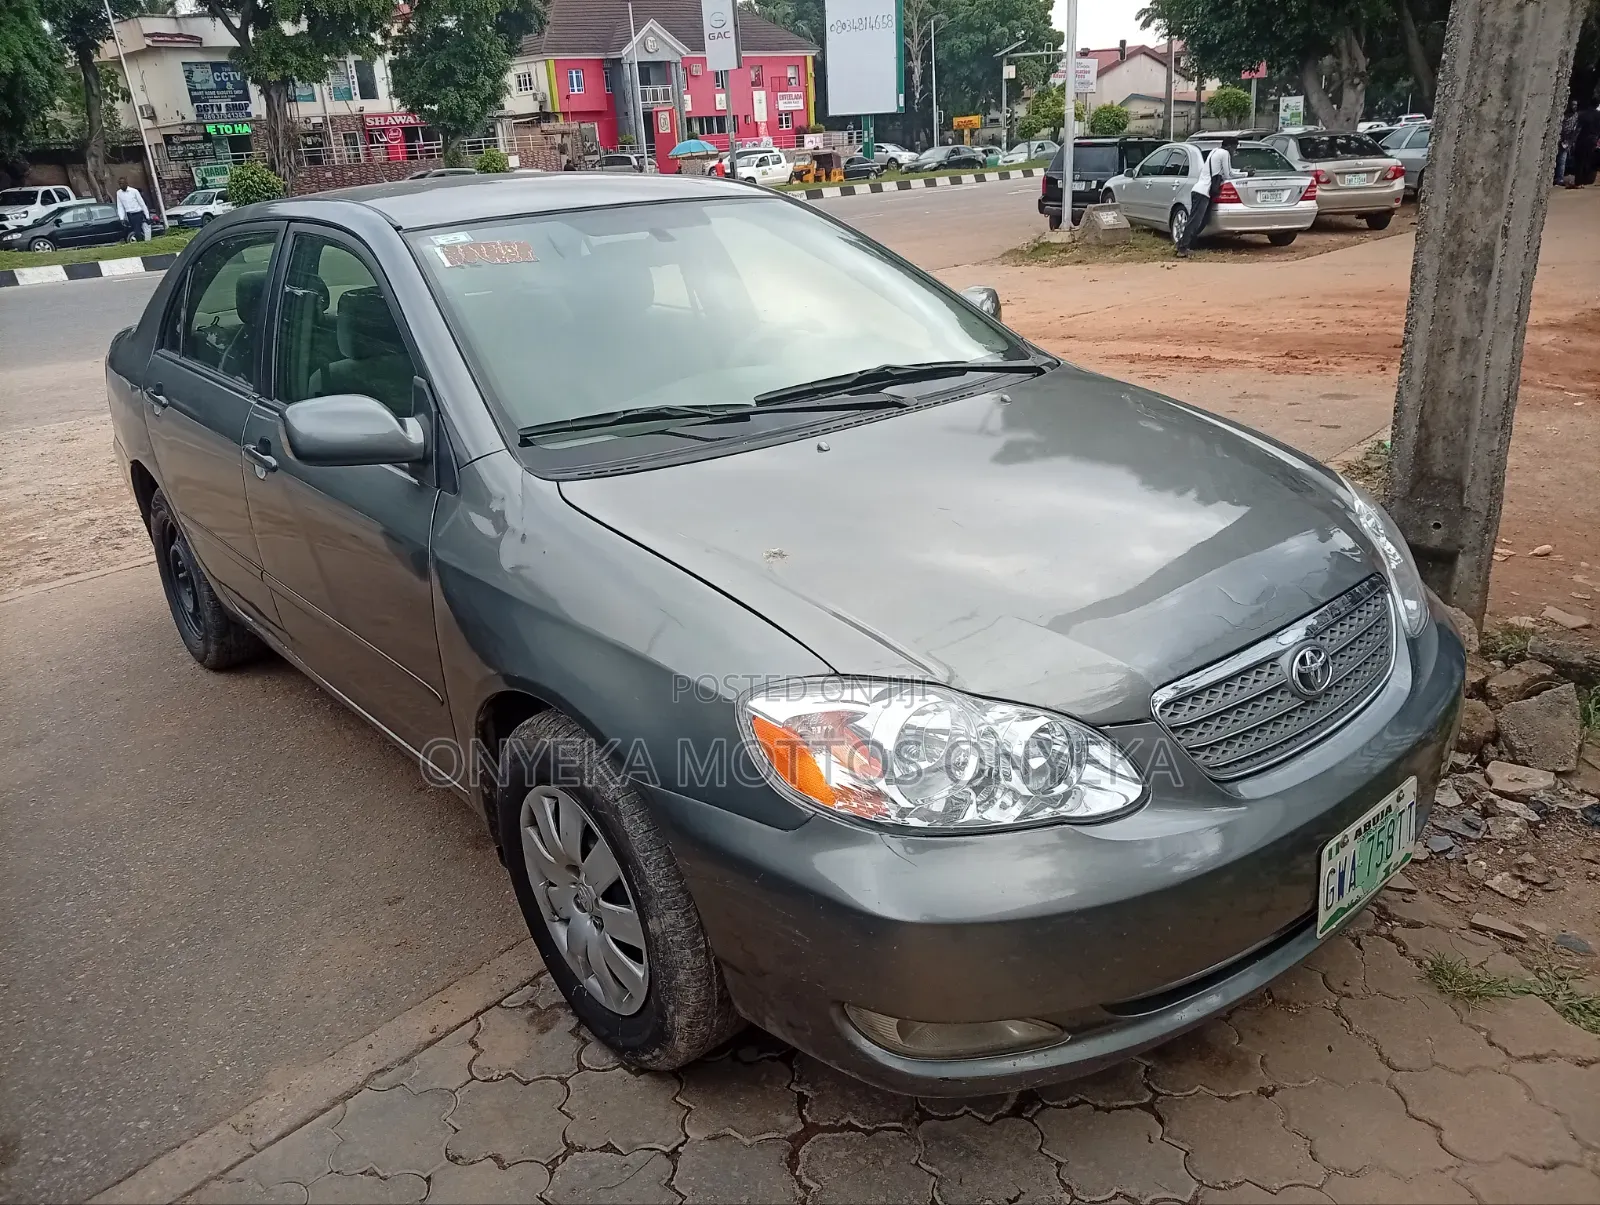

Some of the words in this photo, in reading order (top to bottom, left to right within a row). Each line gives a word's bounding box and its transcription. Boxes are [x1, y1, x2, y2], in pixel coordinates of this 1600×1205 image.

[708, 31, 731, 41] GAC
[213, 71, 241, 82] CCTV
[195, 103, 223, 113] CCTV
[225, 102, 250, 112] SHOP
[217, 124, 233, 134] TO
[203, 165, 229, 178] HABIB
[1353, 803, 1393, 841] ABUJA
